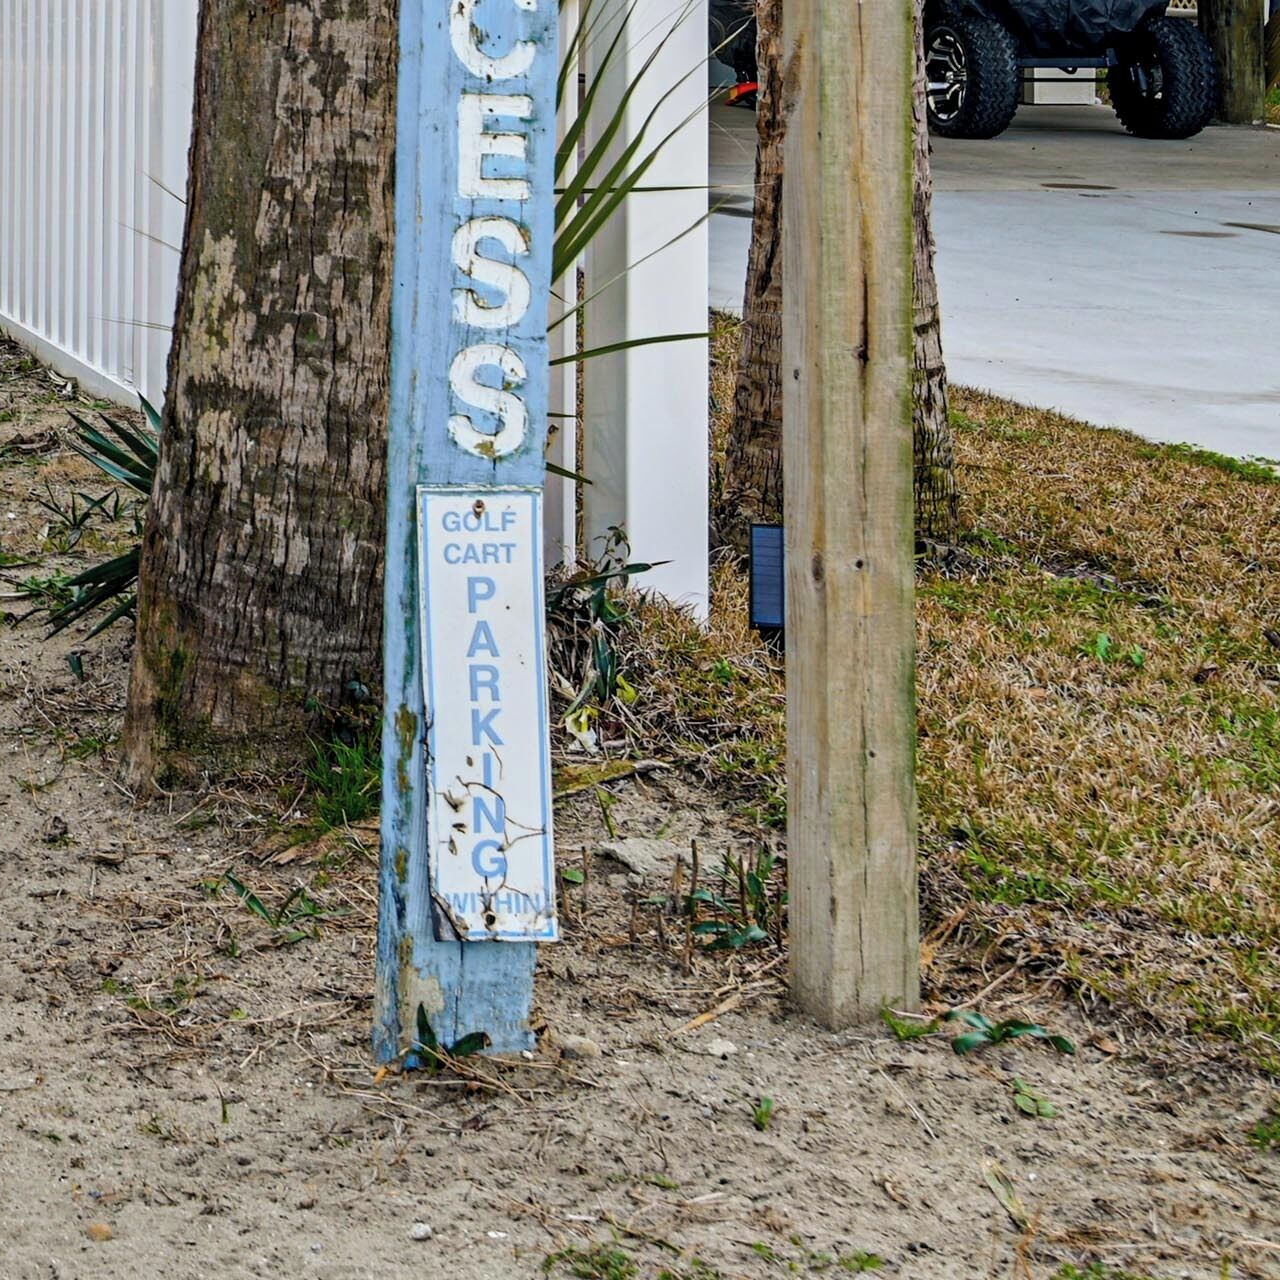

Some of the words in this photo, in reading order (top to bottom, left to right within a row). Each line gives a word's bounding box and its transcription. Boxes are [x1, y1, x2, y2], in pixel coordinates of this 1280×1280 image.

[441, 511, 517, 533] GOLF
[443, 543, 517, 565] CART
[466, 576, 508, 880] PARKING
